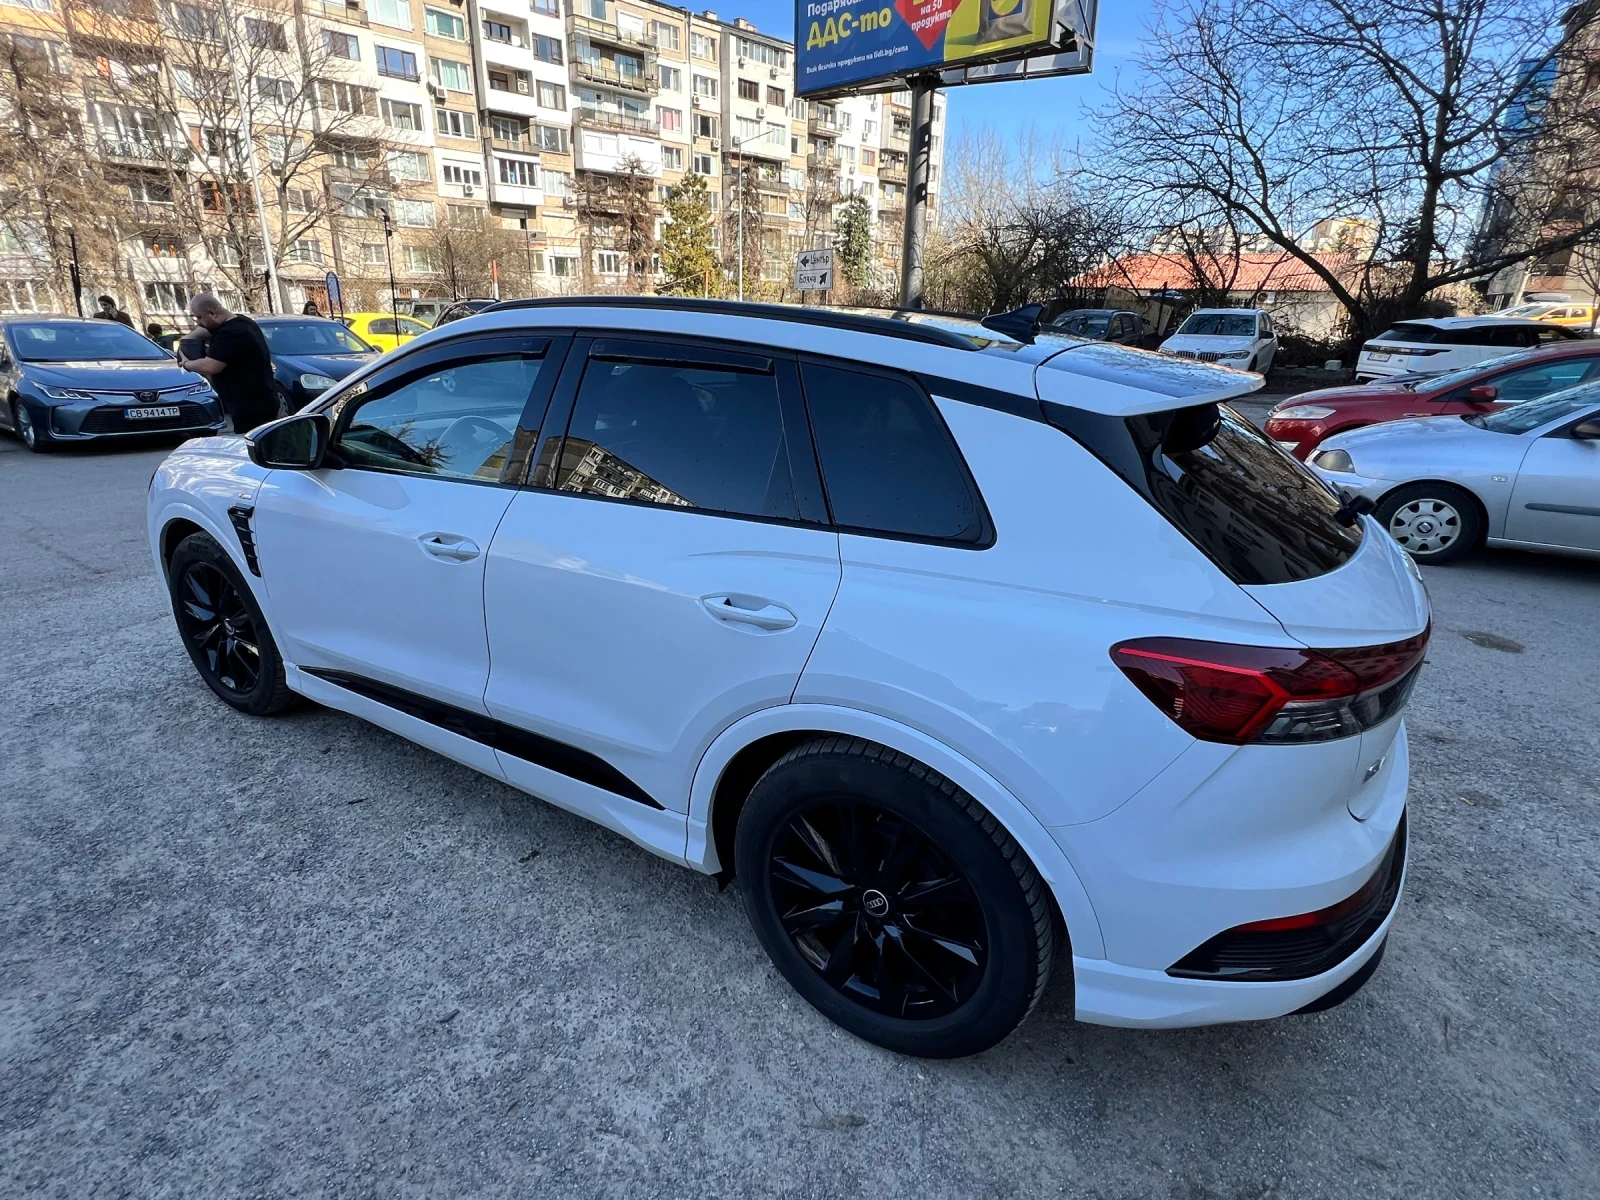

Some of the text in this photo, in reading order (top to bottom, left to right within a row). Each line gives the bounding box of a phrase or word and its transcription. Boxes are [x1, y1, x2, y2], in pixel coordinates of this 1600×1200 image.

[921, 6, 931, 15] на
[932, 0, 943, 11] 50
[911, 9, 952, 32] продукта
[806, 7, 892, 51] ДДС-то
[818, 62, 837, 72] всички
[837, 56, 866, 68] продукти
[810, 255, 829, 265] Център
[144, 408, 165, 417] 9414
